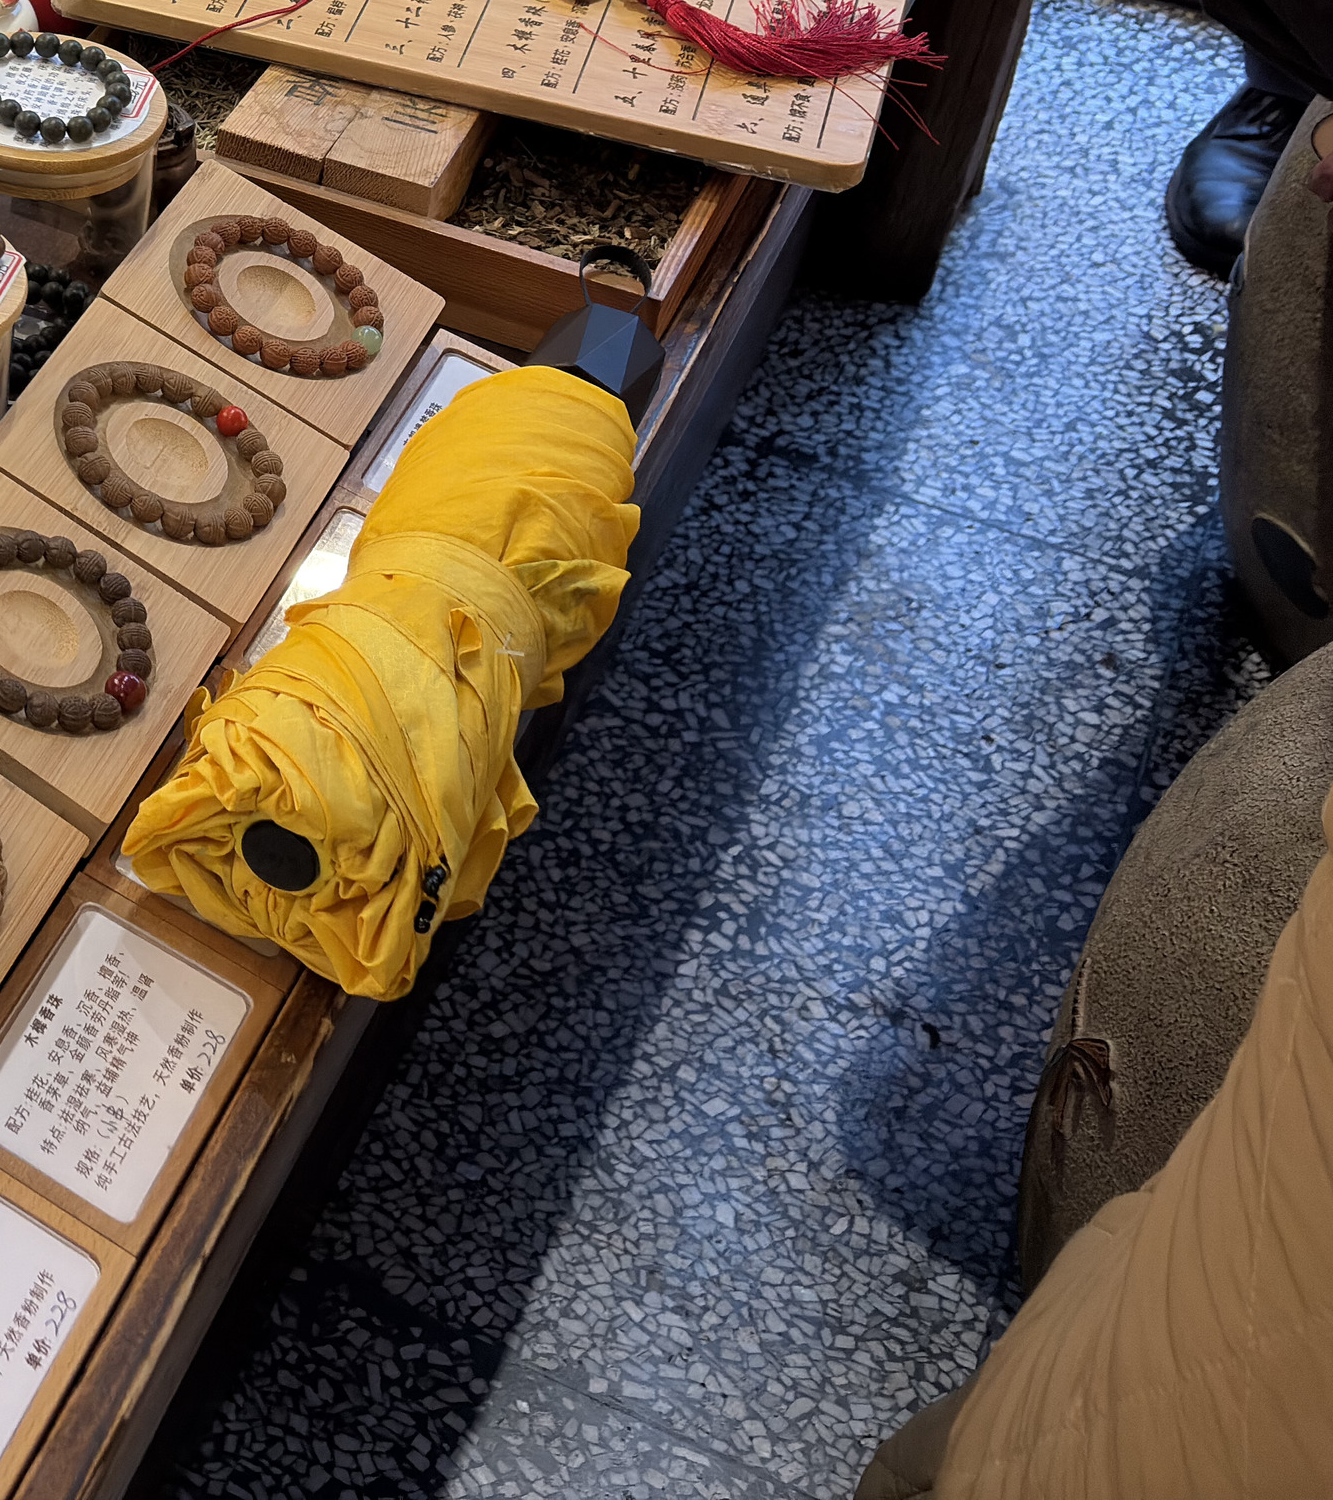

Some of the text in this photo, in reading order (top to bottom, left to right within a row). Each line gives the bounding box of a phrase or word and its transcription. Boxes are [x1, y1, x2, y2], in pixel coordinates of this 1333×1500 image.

[20, 991, 65, 1049] 木樨香珠
[191, 1026, 228, 1067] 228
[88, 1006, 210, 1192] 纯手工古法技艺，天然香粉制作
[36, 1288, 80, 1337] 228
